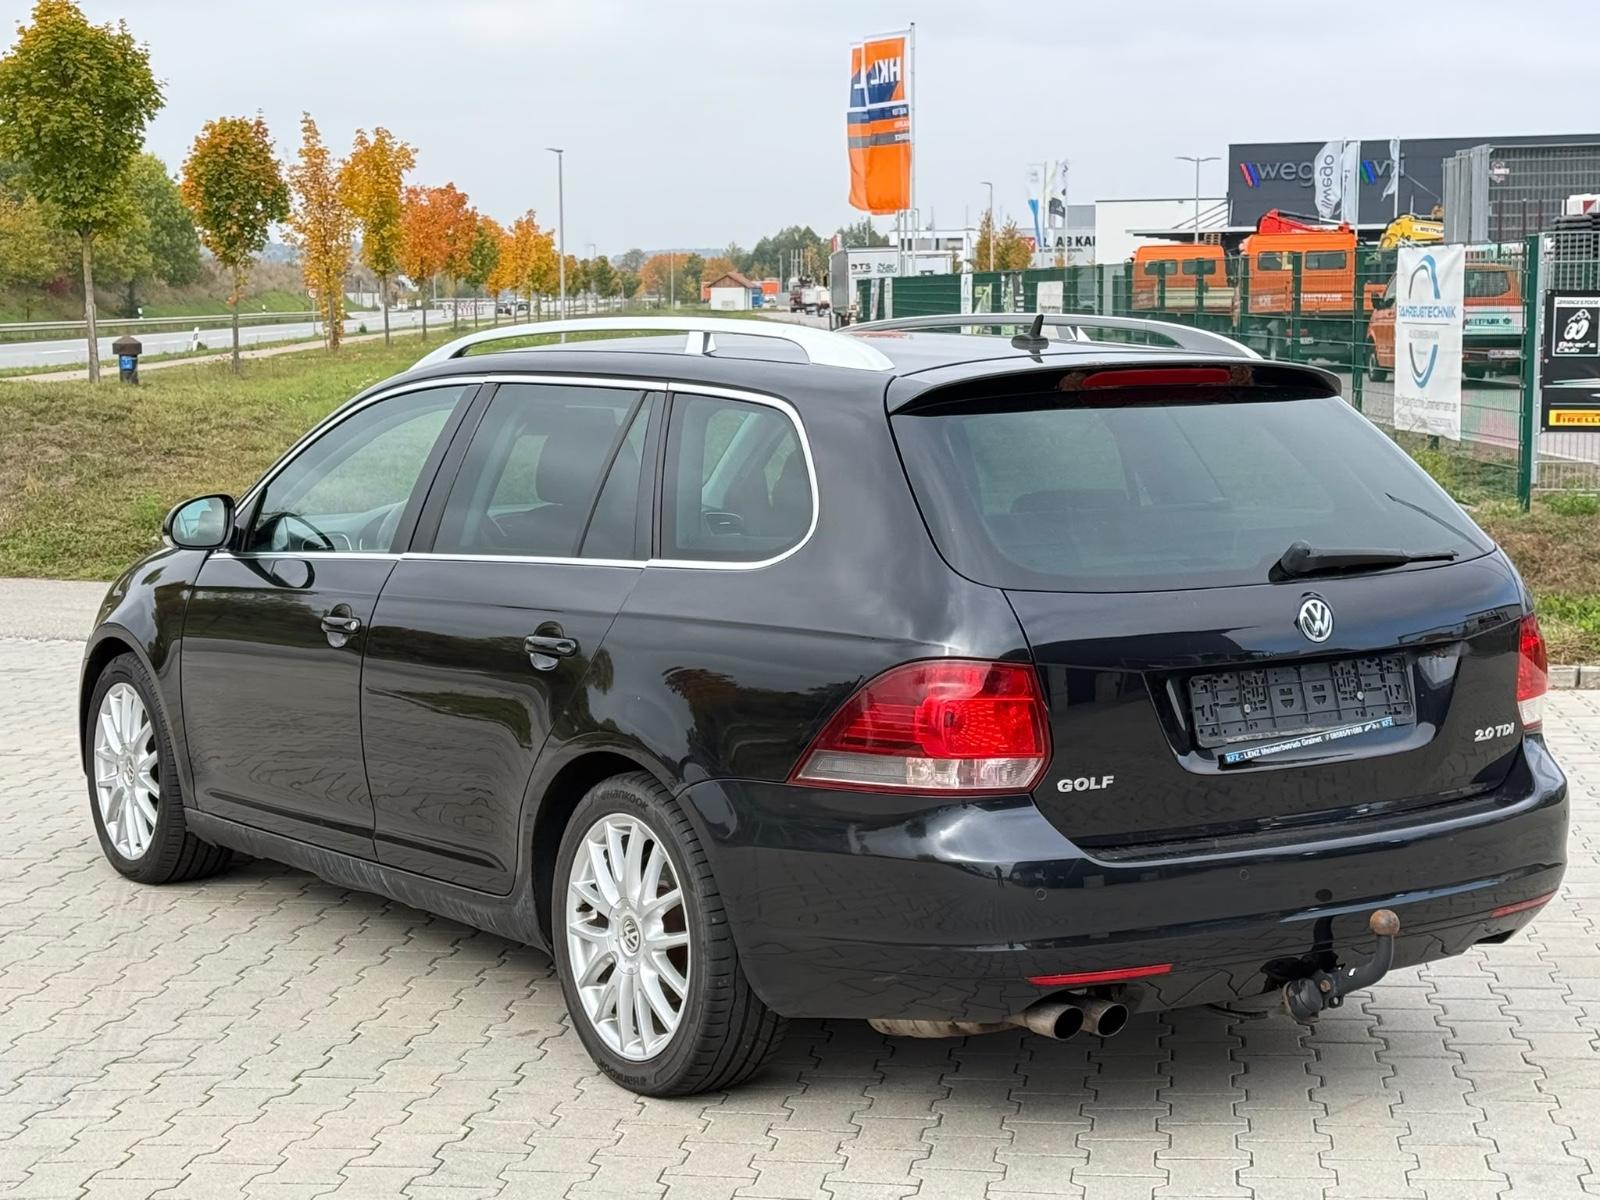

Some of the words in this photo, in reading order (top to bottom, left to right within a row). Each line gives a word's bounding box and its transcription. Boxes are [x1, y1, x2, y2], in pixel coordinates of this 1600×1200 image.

[1257, 161, 1315, 188] weg
[1495, 721, 1515, 738] TDI
[1056, 775, 1115, 793] GOLF
